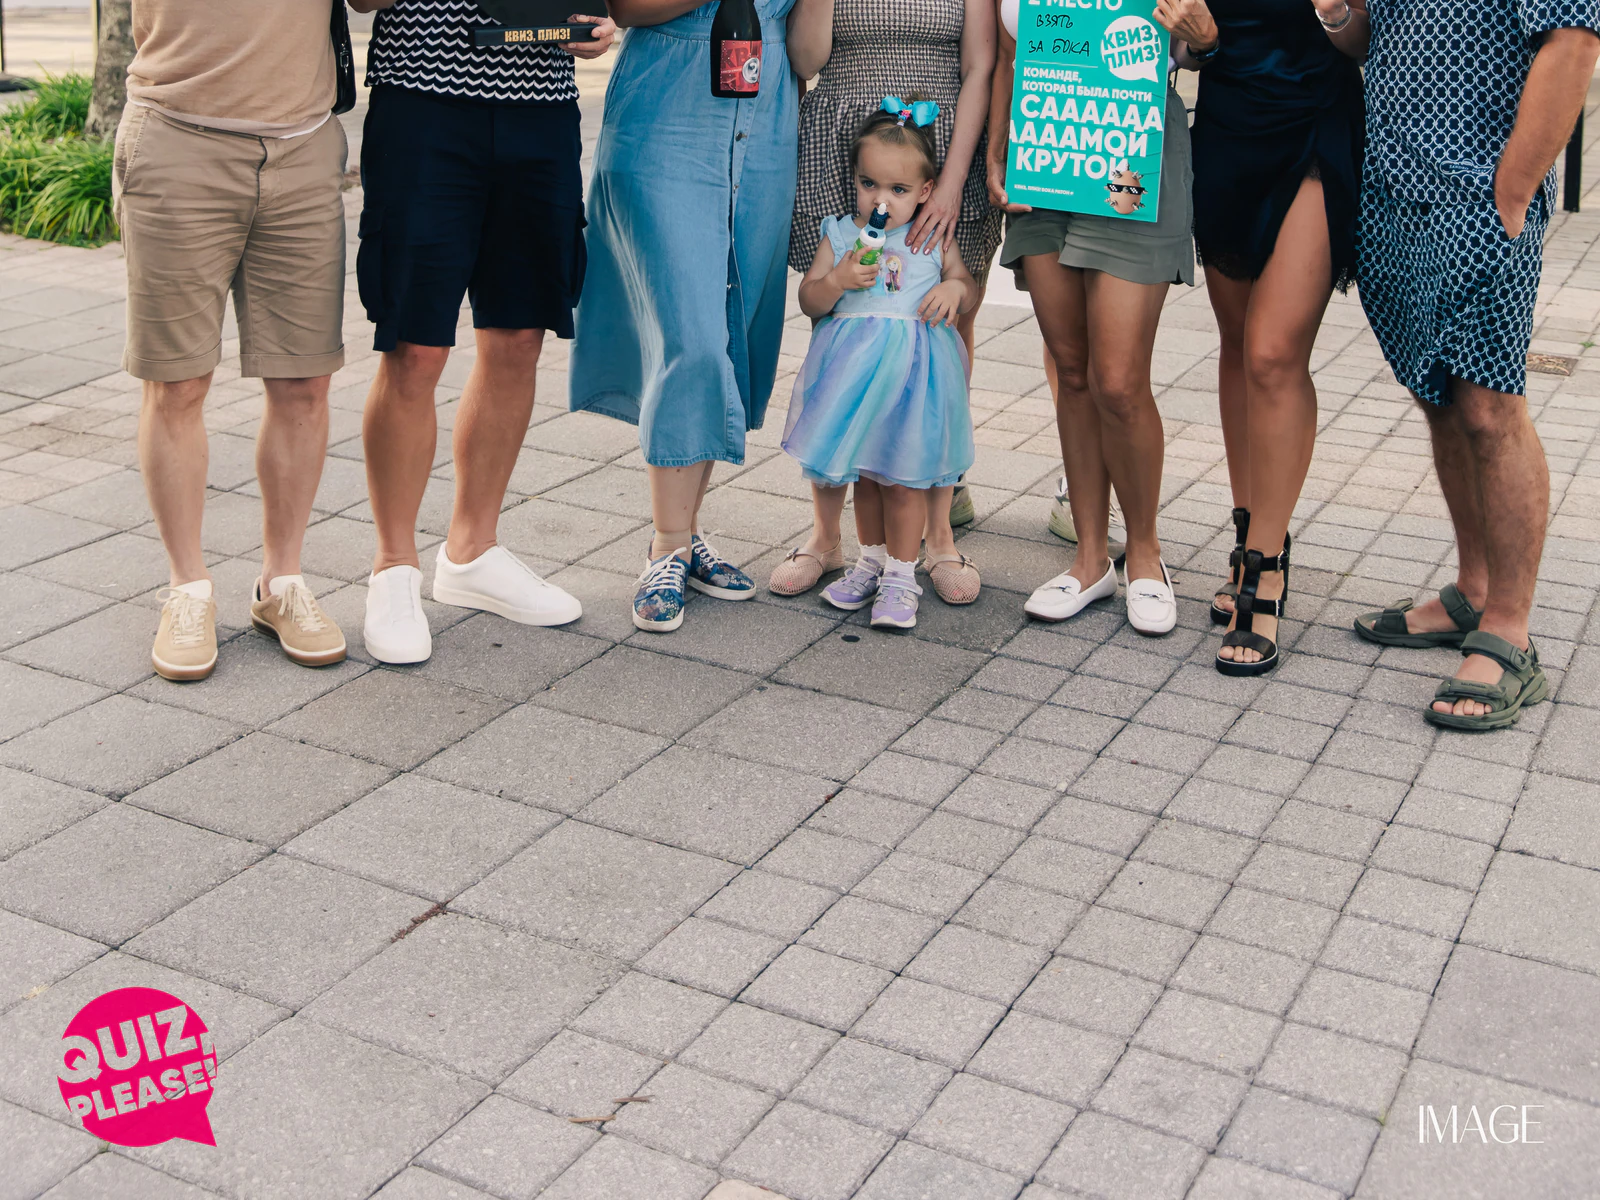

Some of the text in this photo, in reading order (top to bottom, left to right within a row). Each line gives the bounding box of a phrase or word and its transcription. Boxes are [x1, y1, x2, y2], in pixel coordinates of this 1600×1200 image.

[1036, 13, 1073, 28] ВЗЯТЬ
[504, 28, 571, 42] КВИЗ, ПЛИЗ!
[1028, 38, 1090, 57] ЗА БОКА
[1103, 43, 1160, 69] ПЛИЗ!
[1023, 66, 1083, 84] КОМАНДЕ,
[1022, 80, 1152, 102] КОТОРАЯ БЫЛА ПОЧТИ
